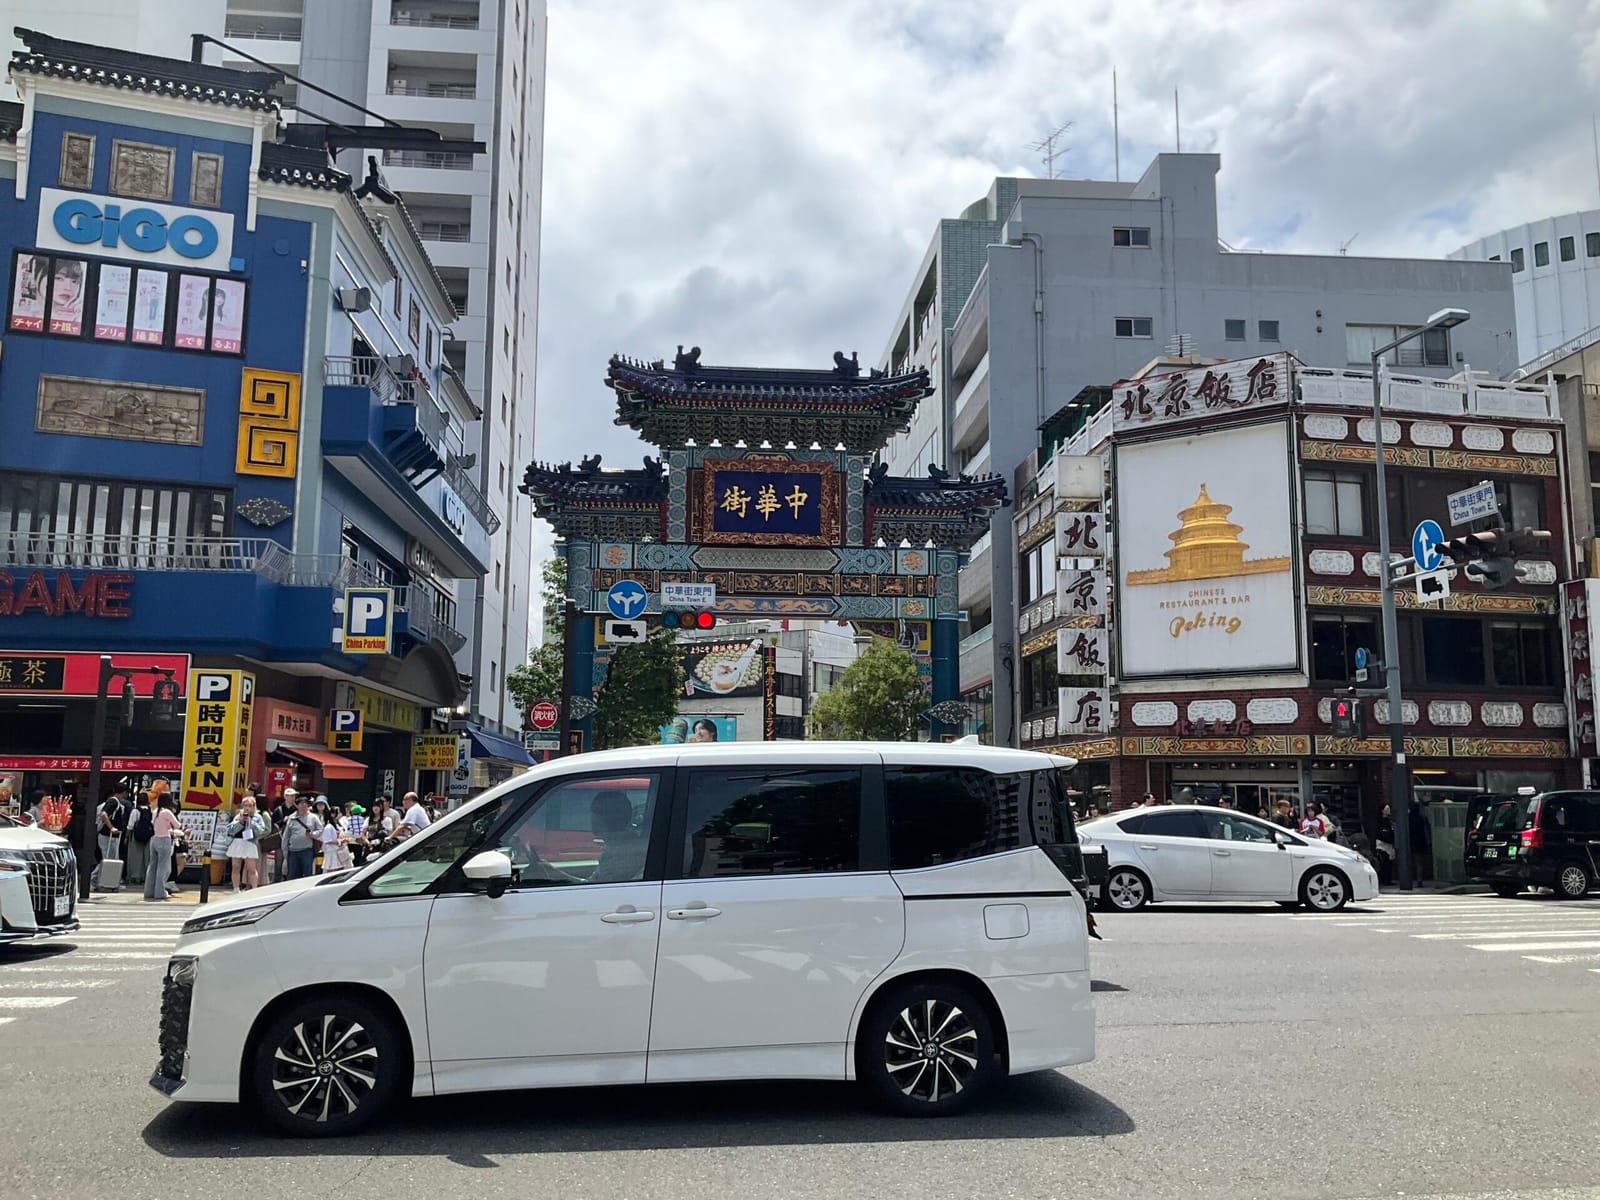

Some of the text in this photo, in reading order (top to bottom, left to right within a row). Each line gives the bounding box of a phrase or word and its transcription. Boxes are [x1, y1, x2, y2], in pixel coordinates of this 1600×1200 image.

[53, 198, 219, 259] GiGO
[14, 317, 42, 328] チャイ
[1120, 358, 1278, 418] 北京飯店
[1450, 486, 1494, 511] 中華街東門
[1453, 510, 1470, 521] China
[1471, 505, 1486, 515] Town
[664, 586, 712, 597] 中華街東門
[1188, 588, 1225, 598] CHINESE
[1160, 595, 1250, 609] RESTAURANT & BAR
[351, 596, 384, 634] P
[1063, 514, 1106, 729] 北京飯店
[1169, 611, 1242, 639] Peking
[346, 638, 386, 650] China Parking
[690, 645, 710, 654] ようこそ
[533, 710, 556, 720] 消火栓
[194, 704, 226, 767] 時間貸
[50, 759, 123, 769] タピオカ門店
[189, 771, 225, 788] IN
[235, 772, 246, 789] IN
